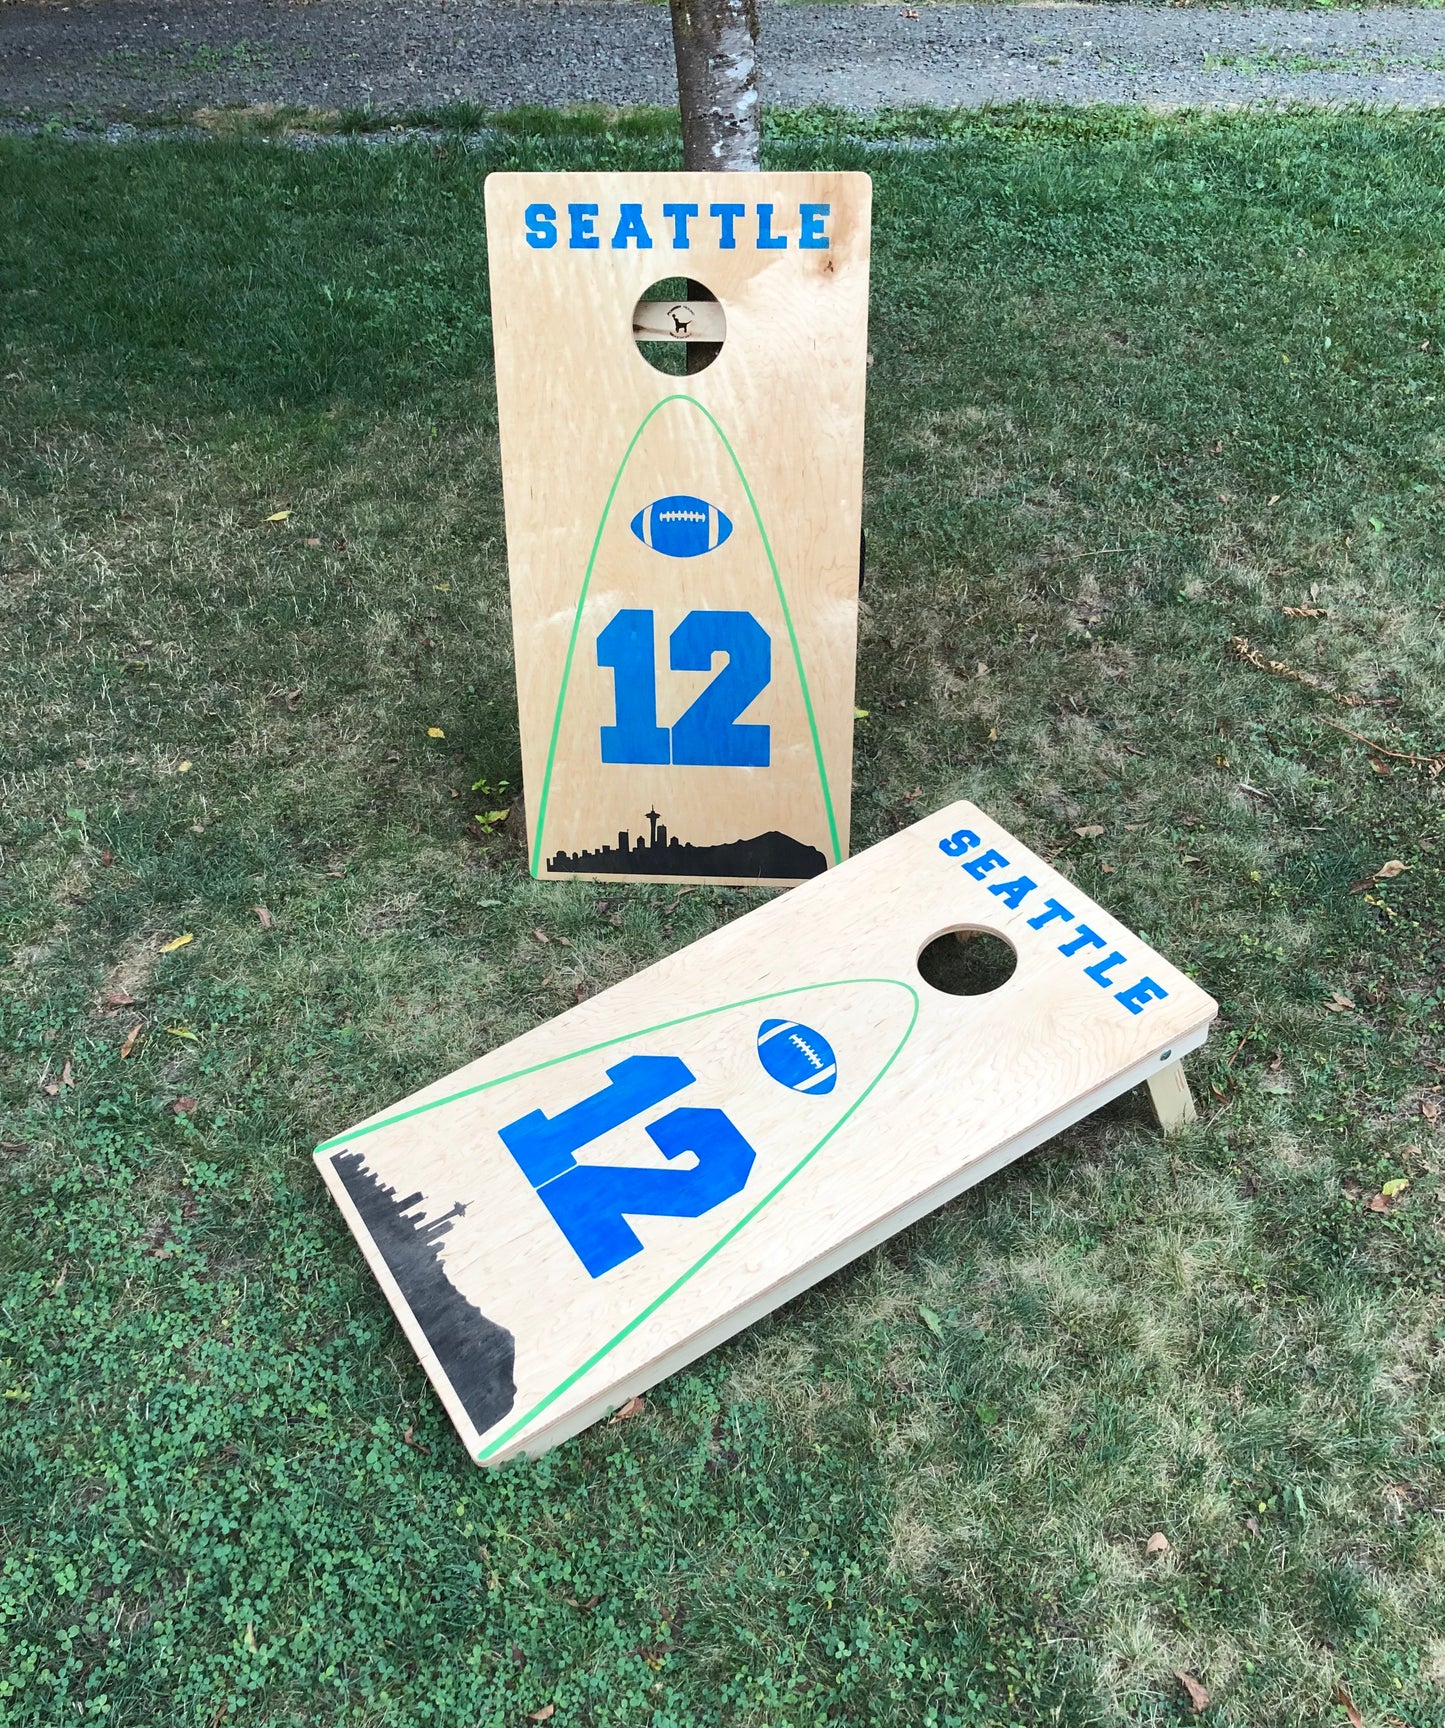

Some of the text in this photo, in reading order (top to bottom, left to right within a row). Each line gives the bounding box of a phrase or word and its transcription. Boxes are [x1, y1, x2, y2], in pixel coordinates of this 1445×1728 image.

[525, 203, 830, 249] SEATTLE
[597, 609, 771, 767] 12
[938, 829, 1168, 1015] SEATTLE
[498, 1055, 757, 1279] 12
